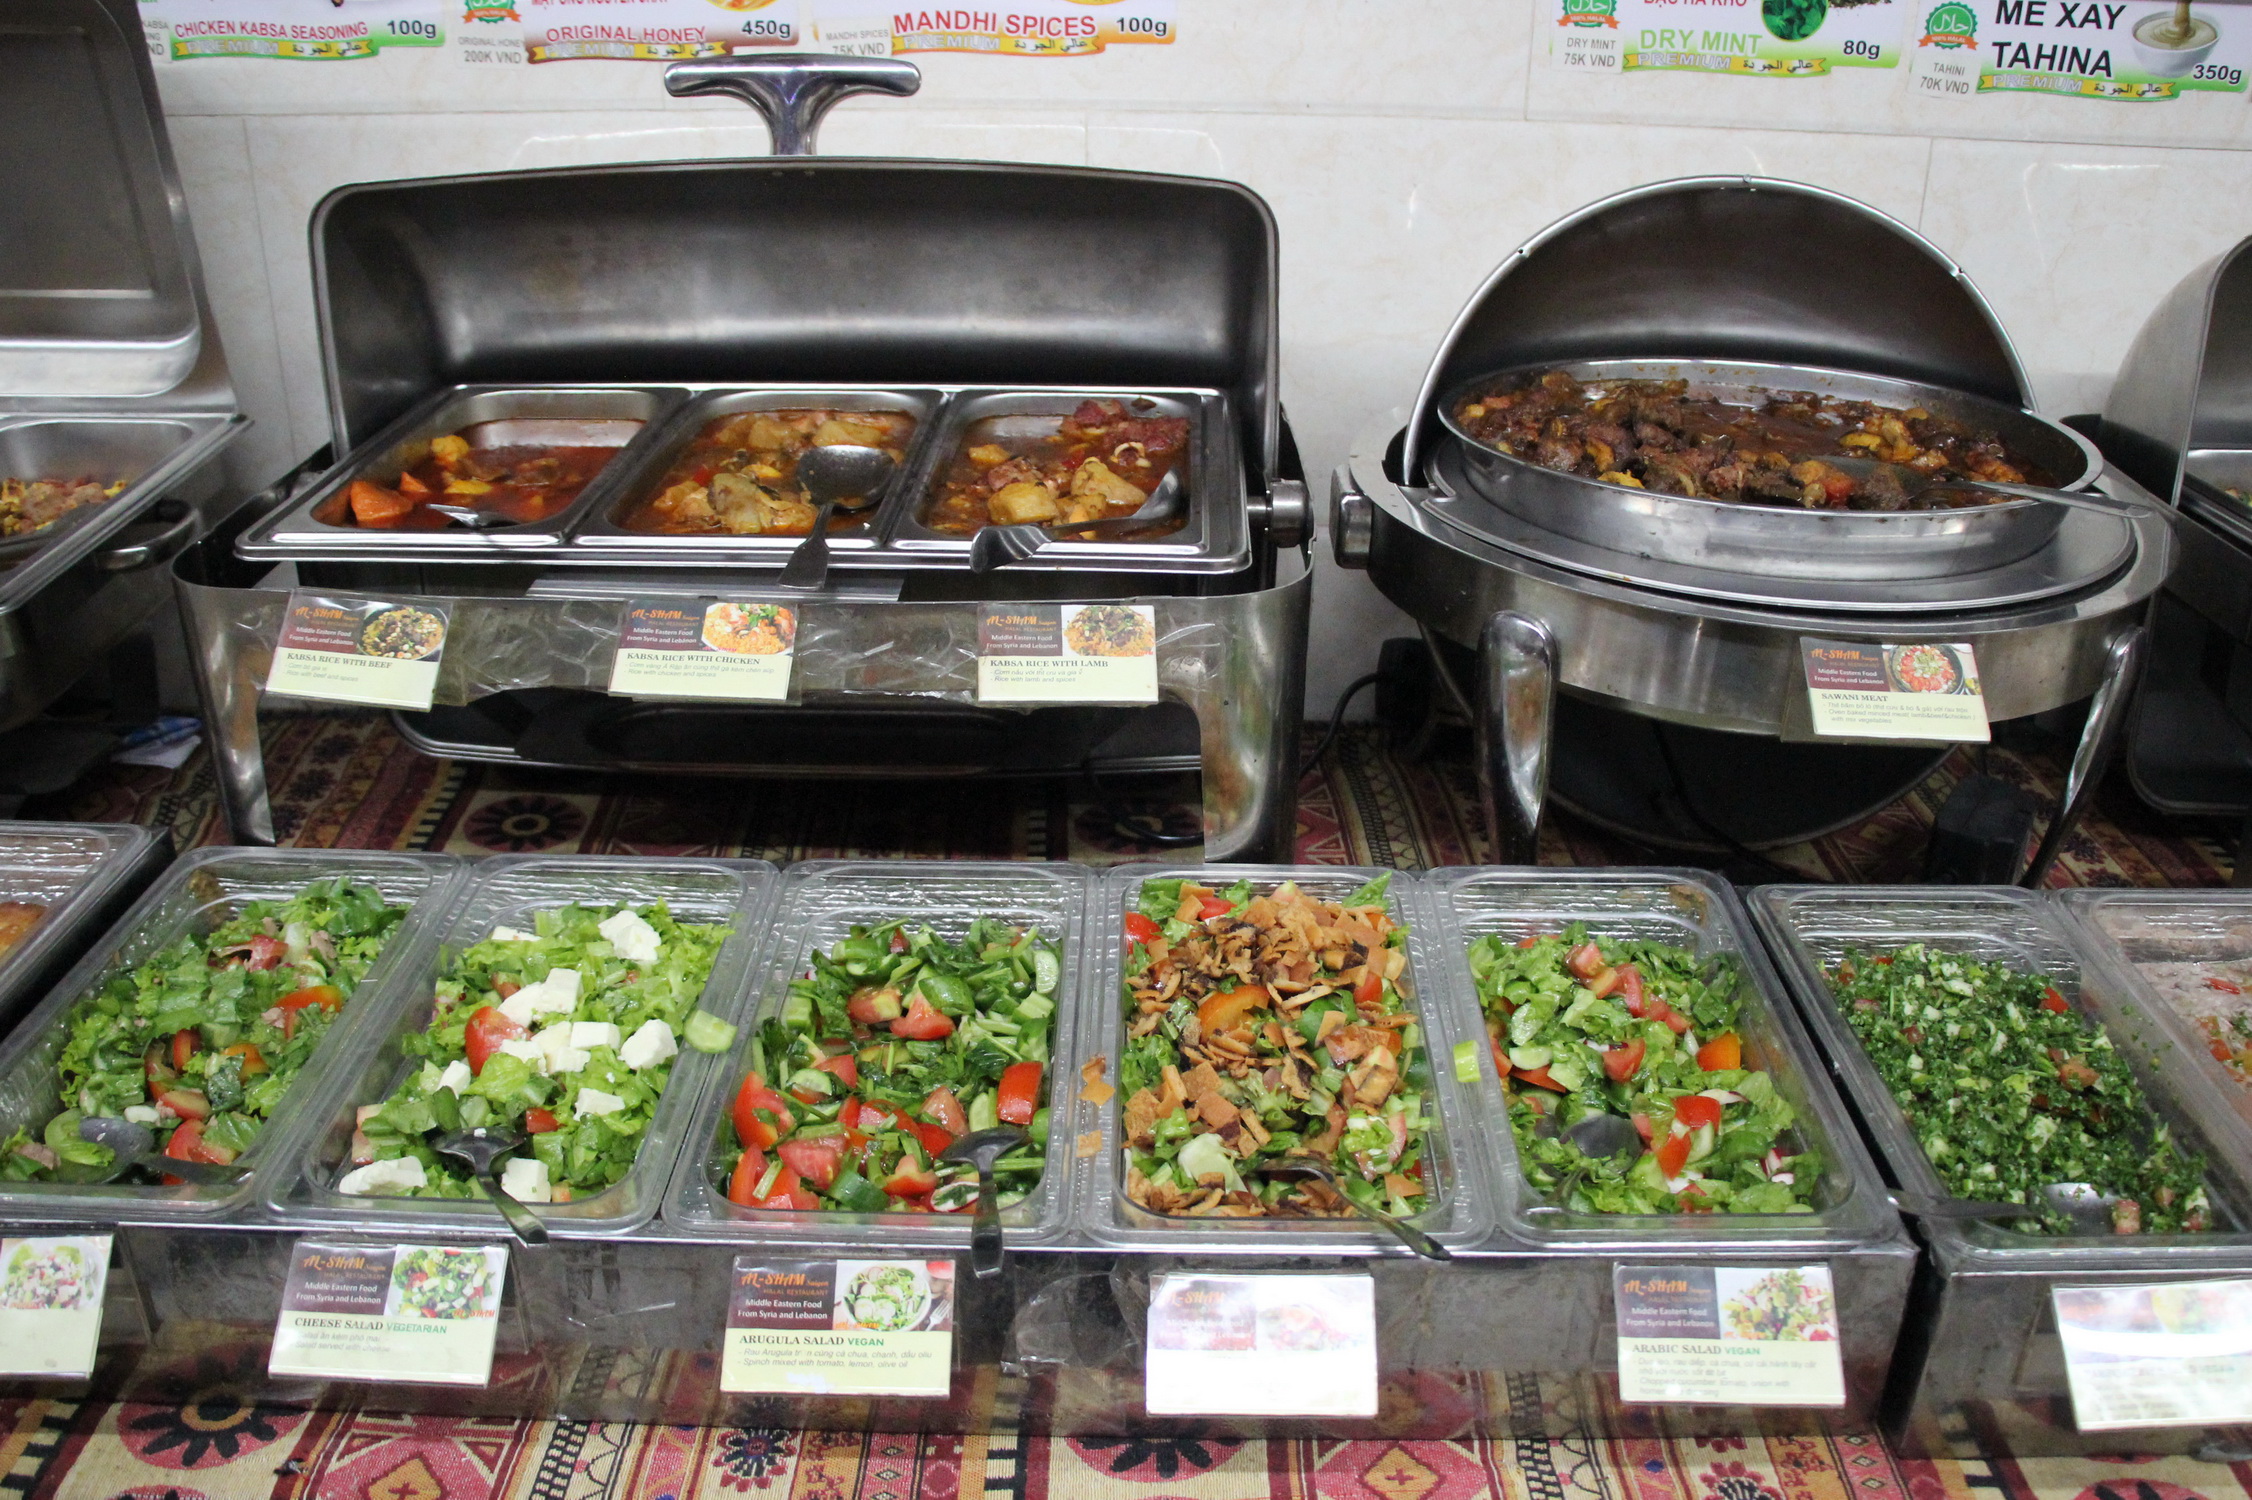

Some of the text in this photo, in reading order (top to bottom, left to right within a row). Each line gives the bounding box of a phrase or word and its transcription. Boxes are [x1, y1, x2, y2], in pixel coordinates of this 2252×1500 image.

[894, 10, 1097, 36] MANDHI SPICES
[2055, 2, 2126, 30] XAY
[175, 20, 236, 38] CHICKEN
[240, 22, 288, 38] KABSA
[291, 25, 368, 39] SEASONING
[387, 20, 436, 38] 100g
[546, 25, 706, 42] ORIGINAL HONEY
[742, 20, 790, 38] 450g
[1117, 17, 1167, 36] 100g
[458, 37, 496, 46] ORIGINAL
[826, 29, 889, 40] MANDHI SPICES
[1640, 29, 1762, 54] DRY MINT
[859, 43, 885, 55] VND
[903, 35, 999, 49] PREMIUM
[1567, 38, 1616, 49] DRY MINT
[545, 42, 634, 58] PREMIUM
[1843, 40, 1880, 59] 80g
[464, 50, 521, 64] 200K VND
[1564, 53, 1615, 67] 75K VND
[1637, 52, 1731, 70] PREMIUM
[1992, 42, 2112, 78] TAHINA
[1933, 62, 1965, 75] TAHINI
[2193, 64, 2242, 84] 350g
[1920, 76, 1970, 94] 70K VND
[1993, 74, 2082, 92] PREMIUM
[287, 653, 392, 669] KABSA RICE WITH BEEF
[627, 652, 659, 660] KABSA
[687, 655, 712, 663] WITH
[715, 657, 760, 665] CHICKEN
[304, 1281, 378, 1293] Middle Eastern Food
[741, 1273, 805, 1288] AL-SHAM
[296, 1292, 381, 1304] From Syria and Lebanon
[745, 1298, 823, 1308] Middle Eastern Food
[737, 1309, 828, 1320] From Syria and Lebanon
[1631, 1308, 1707, 1316] Middle Eastern Food
[295, 1317, 447, 1335] CHEESE SALAD VEGETARIAN
[1626, 1319, 1646, 1327] From
[1647, 1319, 1666, 1328] Syria
[1682, 1320, 1715, 1328] Lebanon
[740, 1335, 884, 1346] ARUGULA SALAD VEGAN
[762, 1349, 793, 1358] Arugula
[1632, 1344, 1760, 1355] ARABIC SALAD VEGAN
[743, 1358, 771, 1367] Spinch
[772, 1359, 797, 1367] mixed
[799, 1359, 814, 1368] with
[816, 1360, 845, 1369] tomato,
[877, 1360, 897, 1369] olive
